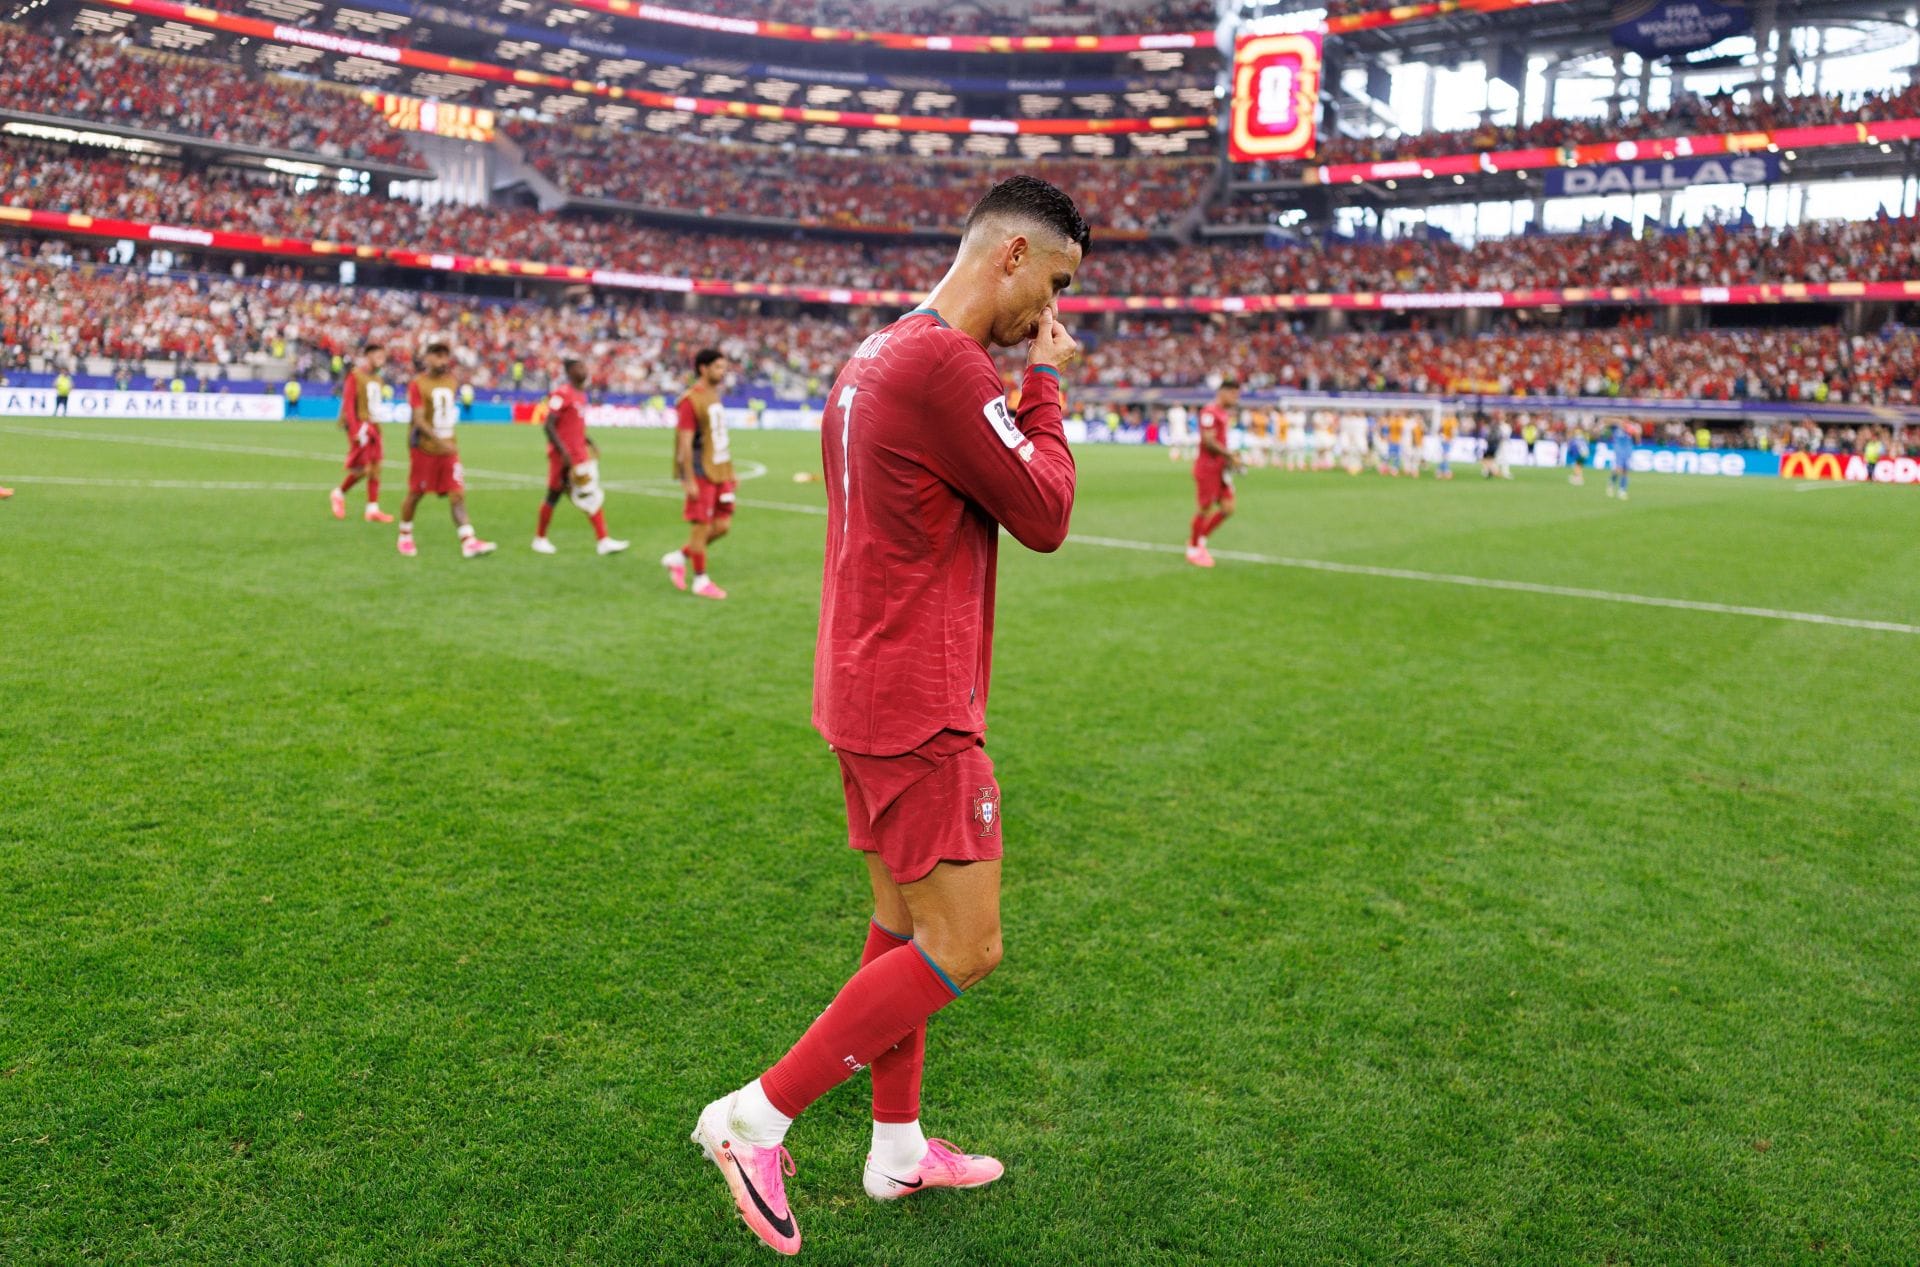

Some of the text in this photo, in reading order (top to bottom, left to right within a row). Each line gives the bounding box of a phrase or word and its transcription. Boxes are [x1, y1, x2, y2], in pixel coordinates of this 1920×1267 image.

[1563, 157, 1767, 194] DALLAS
[125, 395, 244, 415] AMERICA
[838, 384, 857, 534] 1
